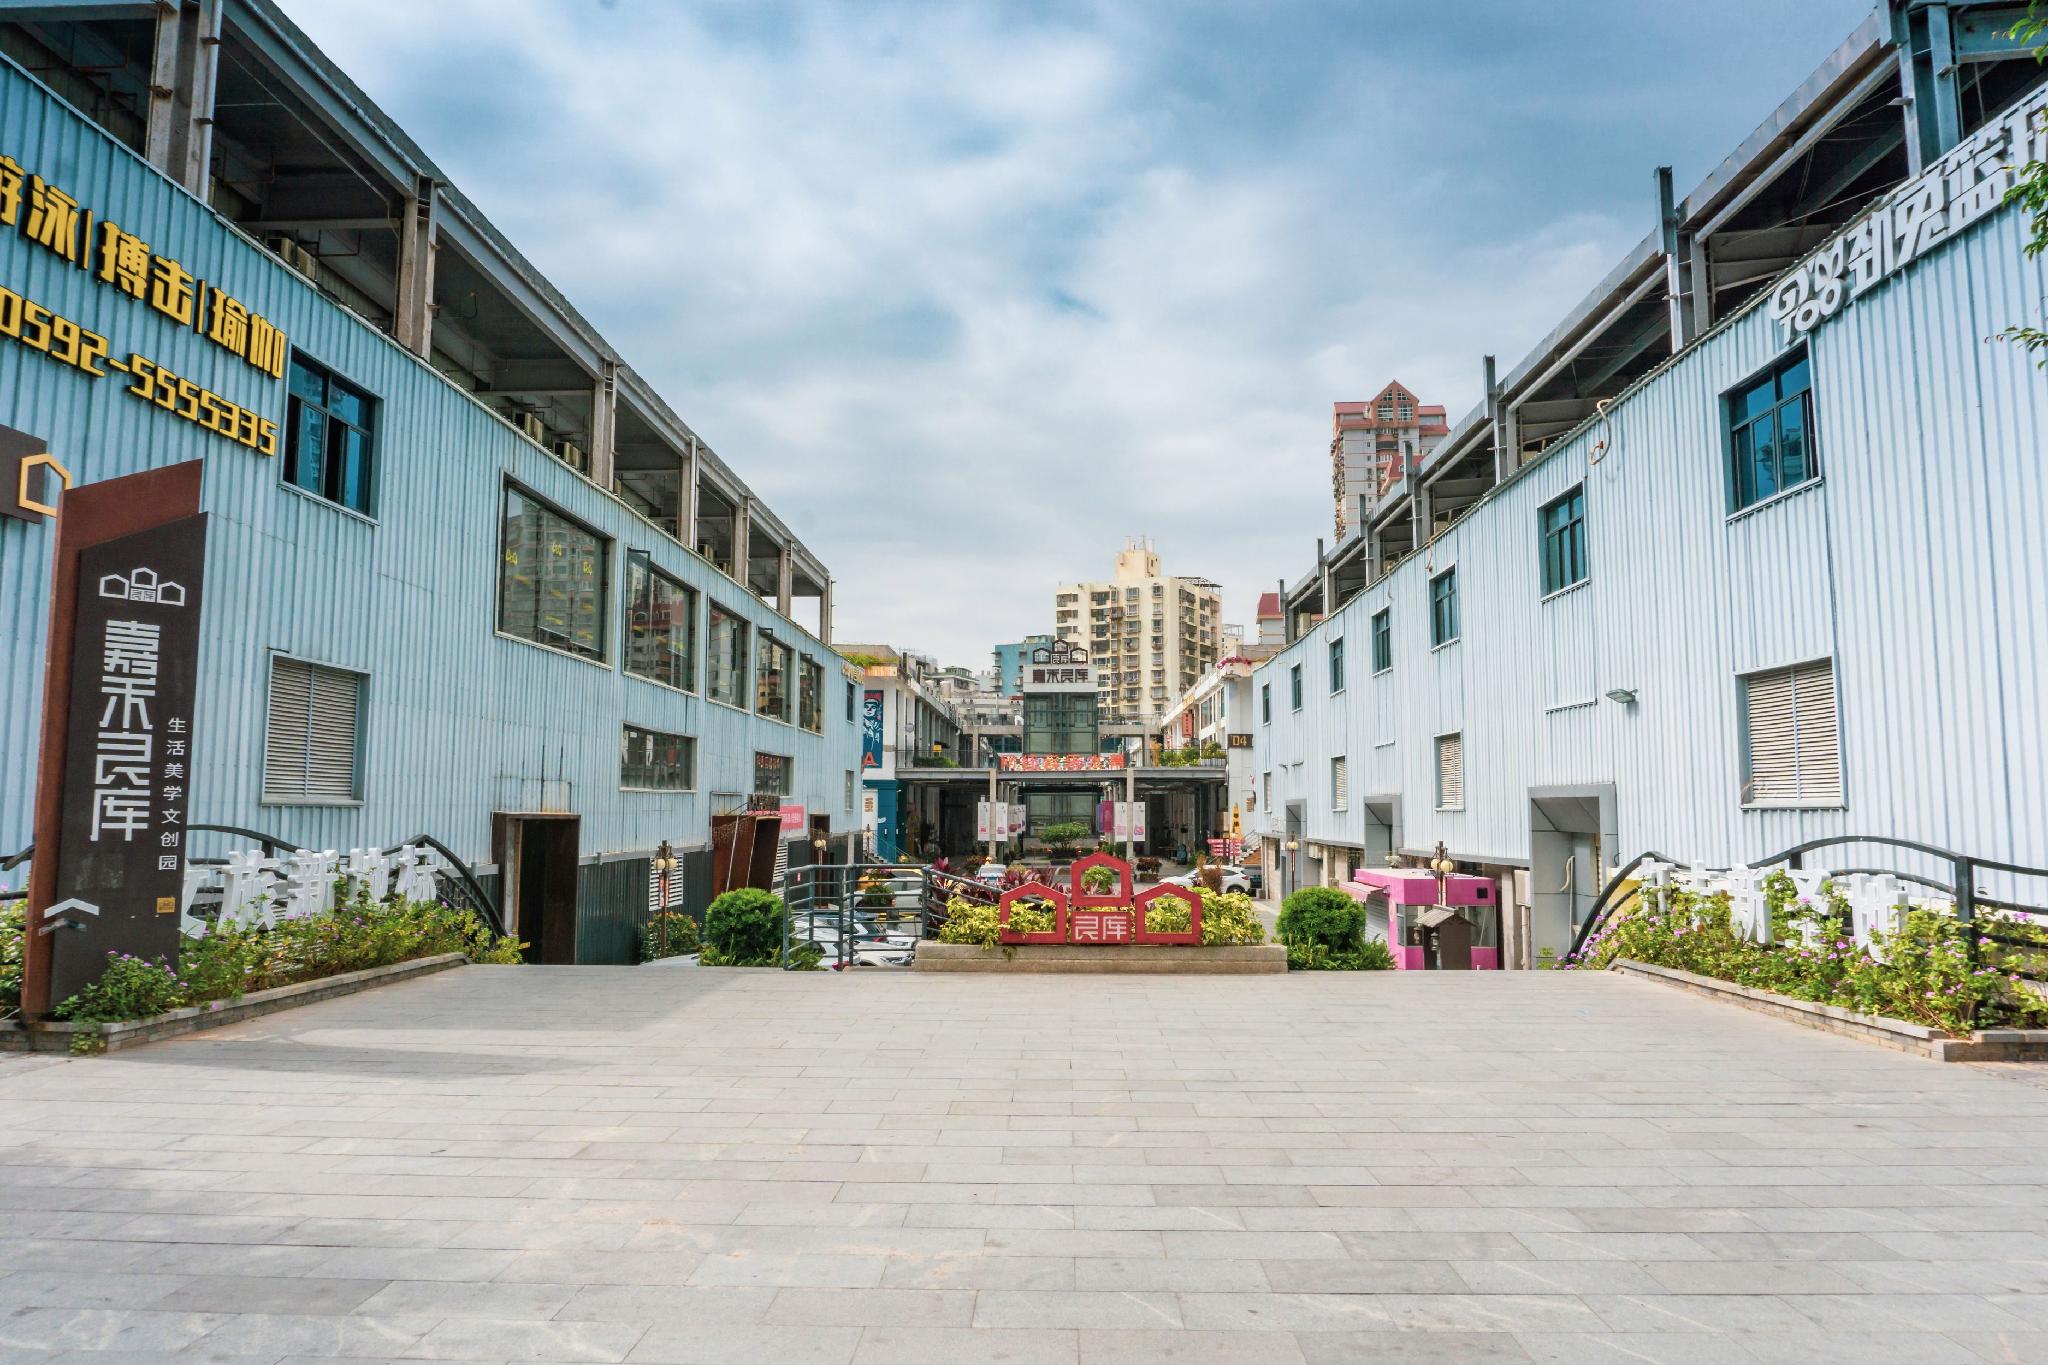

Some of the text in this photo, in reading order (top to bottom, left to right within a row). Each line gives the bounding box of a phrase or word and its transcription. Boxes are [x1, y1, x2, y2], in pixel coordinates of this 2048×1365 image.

[1779, 278, 1842, 345] TOO
[90, 619, 161, 842] 嘉禾良库
[158, 716, 187, 871] 生活美学文创园
[1074, 915, 1128, 941] 良库
